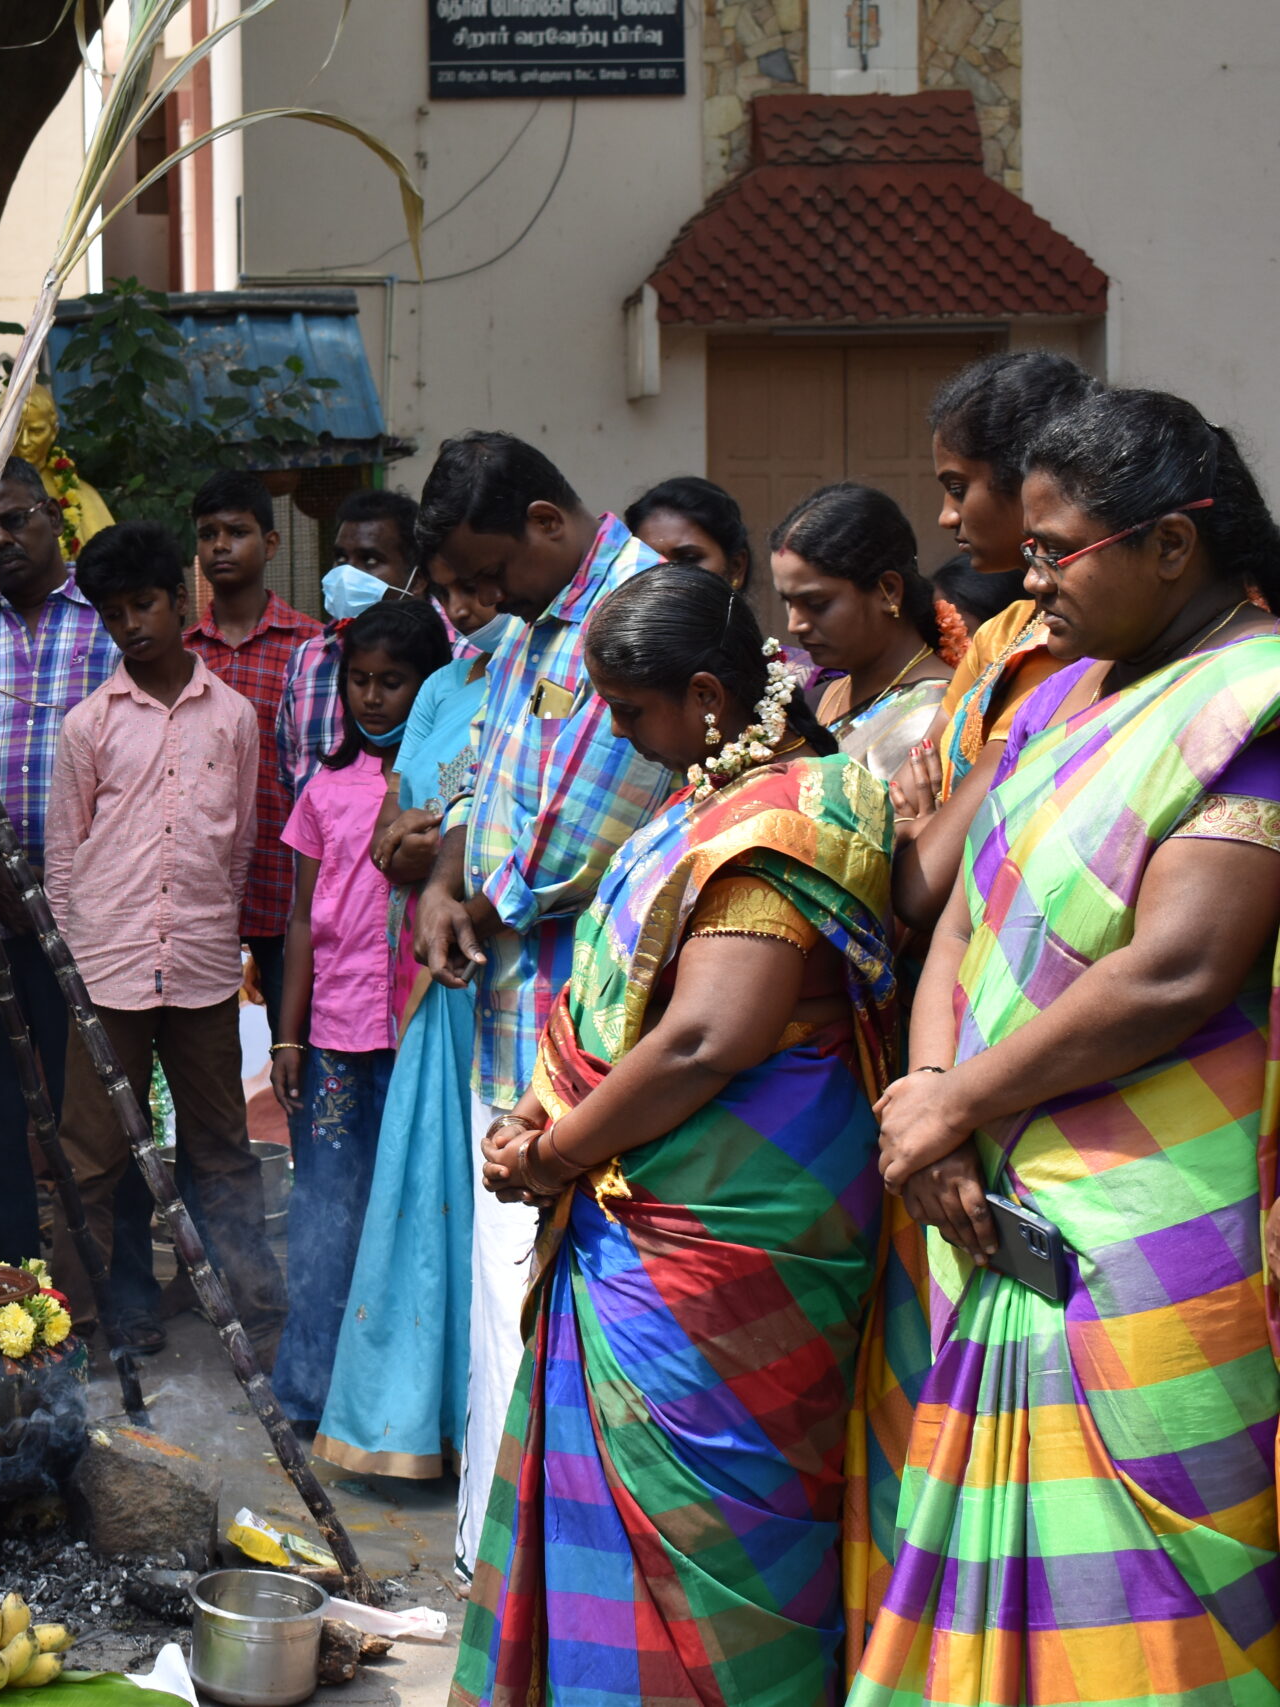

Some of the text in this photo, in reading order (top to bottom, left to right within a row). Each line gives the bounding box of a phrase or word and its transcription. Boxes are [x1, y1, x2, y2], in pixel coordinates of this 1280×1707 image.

[452, 24, 664, 49] சிறார் வரவேற்பு பிரிவு
